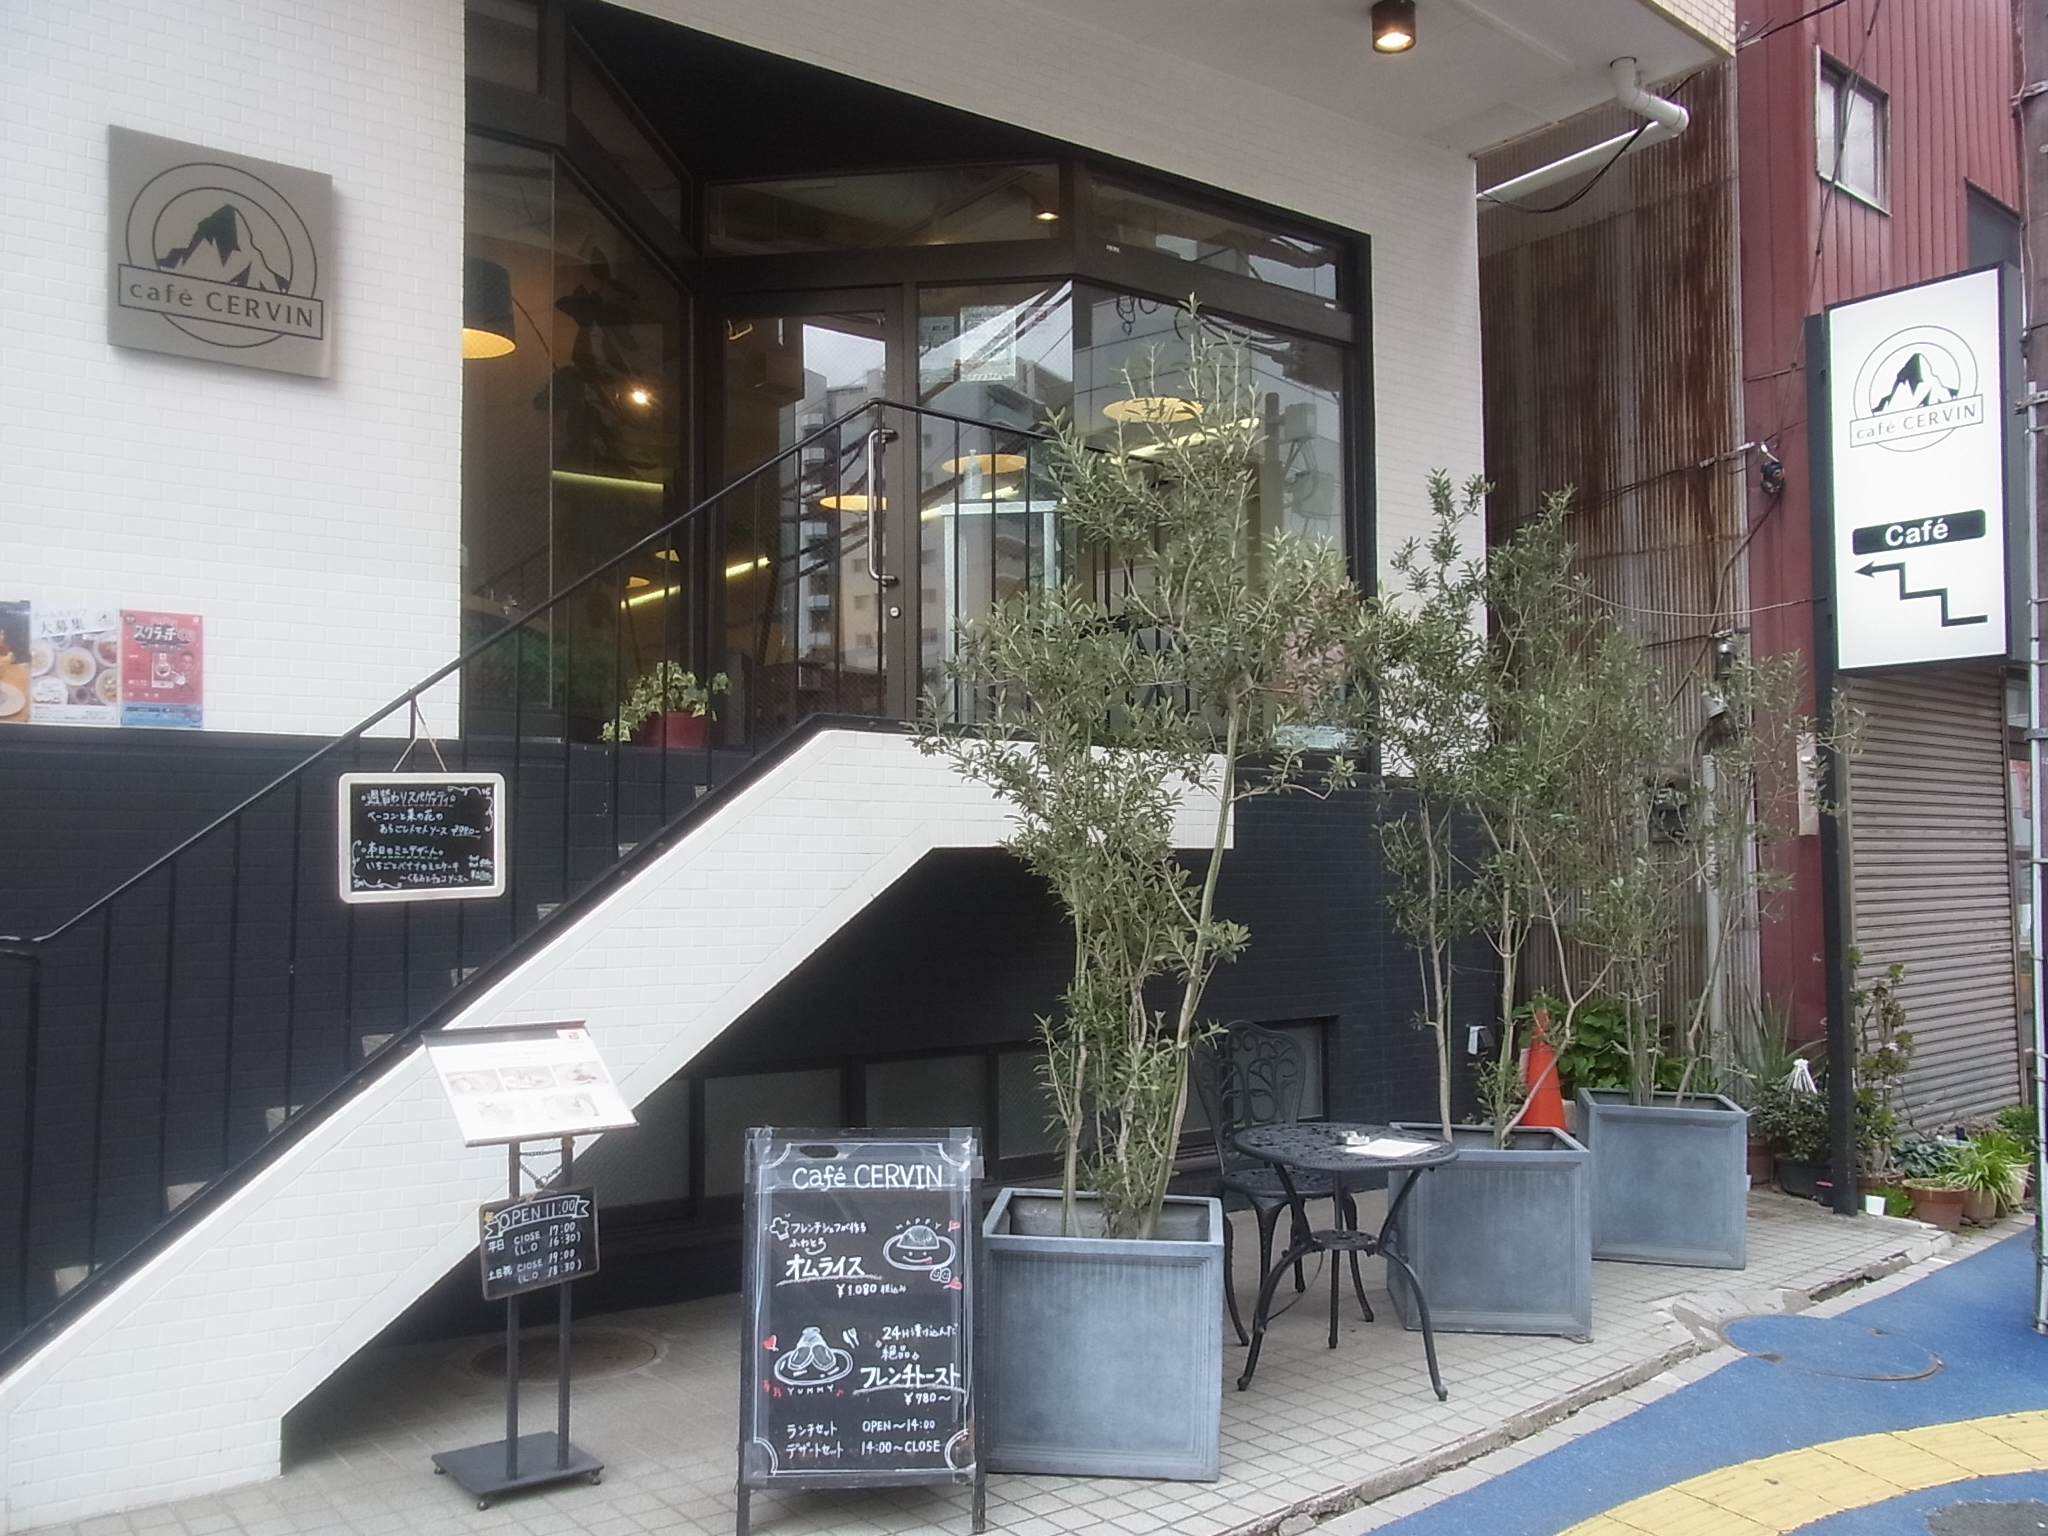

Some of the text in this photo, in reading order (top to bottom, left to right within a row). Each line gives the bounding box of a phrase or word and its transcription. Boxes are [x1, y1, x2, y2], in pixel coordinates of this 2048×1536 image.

[129, 283, 313, 327] café CERVIN
[1856, 403, 1975, 440] café CERVIN
[1885, 518, 1948, 547] Café
[40, 618, 85, 634] 大募集
[792, 1163, 943, 1191] Café CERVIN
[499, 1199, 576, 1229] OPEN 11:00
[895, 1217, 942, 1231] HAPPY
[488, 1239, 505, 1253] 平日
[549, 1222, 576, 1236] 17:00
[788, 1237, 828, 1255] ふわとろ
[548, 1249, 576, 1264] 19:00
[785, 1253, 866, 1281] オムライス
[881, 1344, 910, 1361] 絶品
[860, 1362, 961, 1389] フレンチトースト
[787, 1384, 834, 1395] YUMMY
[786, 1421, 838, 1439] ランチセット
[786, 1441, 844, 1459] デザートセット
